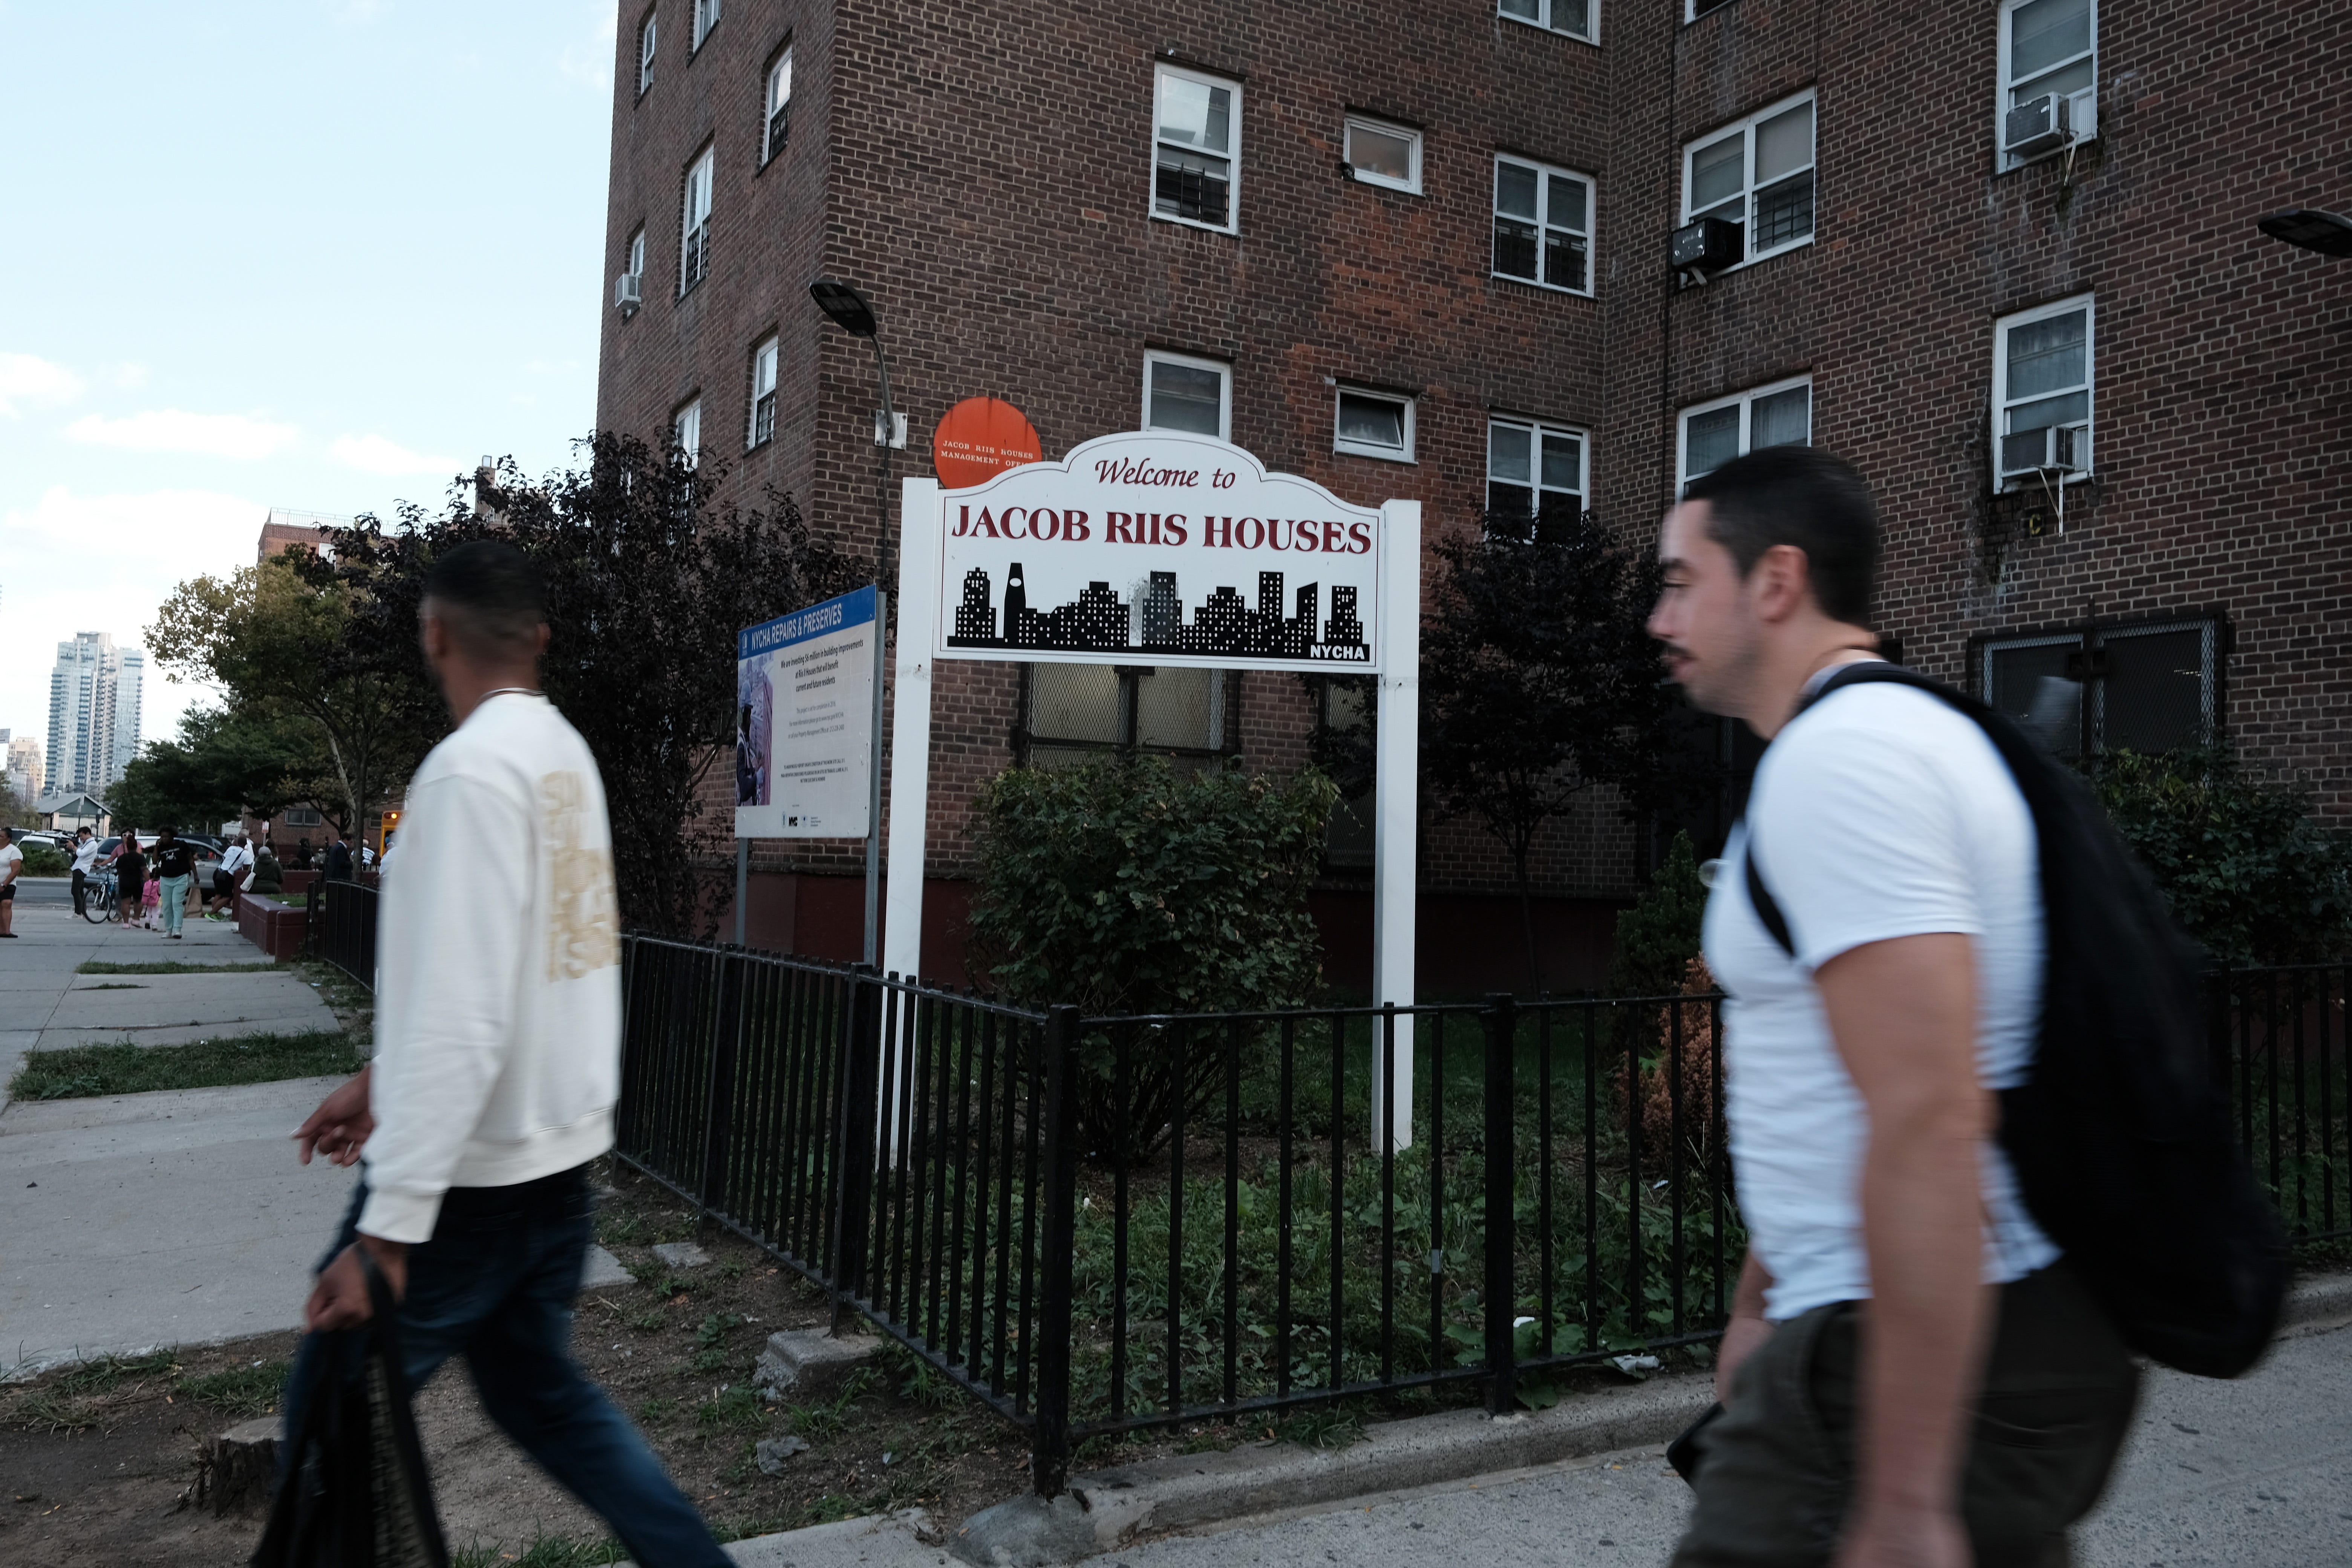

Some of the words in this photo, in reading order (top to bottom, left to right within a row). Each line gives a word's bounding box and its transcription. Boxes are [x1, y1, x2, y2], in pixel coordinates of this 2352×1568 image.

[941, 450, 999, 465] MANAGEMENT
[943, 440, 969, 450] JACOB
[975, 444, 995, 454] RIIS
[1001, 449, 1034, 459] HOUSES
[1095, 456, 1199, 488] Welcome
[1211, 468, 1236, 488] to
[951, 505, 1090, 542] JACOB
[1104, 511, 1188, 546] RIIS
[1202, 515, 1371, 554] HOUSES
[752, 627, 771, 651] NYCHA
[772, 618, 796, 644] REPAIRS
[798, 616, 802, 637] &
[803, 603, 842, 635] PRESERVES
[781, 660, 786, 669] We
[791, 655, 804, 666] investing
[805, 653, 809, 663] $6
[809, 651, 820, 661] million
[821, 649, 824, 658] in
[824, 645, 838, 656] building
[838, 638, 864, 655] improvements
[1310, 645, 1365, 660] NYCHA
[795, 671, 798, 679] at
[806, 667, 816, 676] Houses
[828, 659, 839, 671] benefit
[796, 683, 806, 692] current
[812, 679, 821, 688] future
[822, 676, 835, 687] residents
[789, 816, 798, 827] NYC
